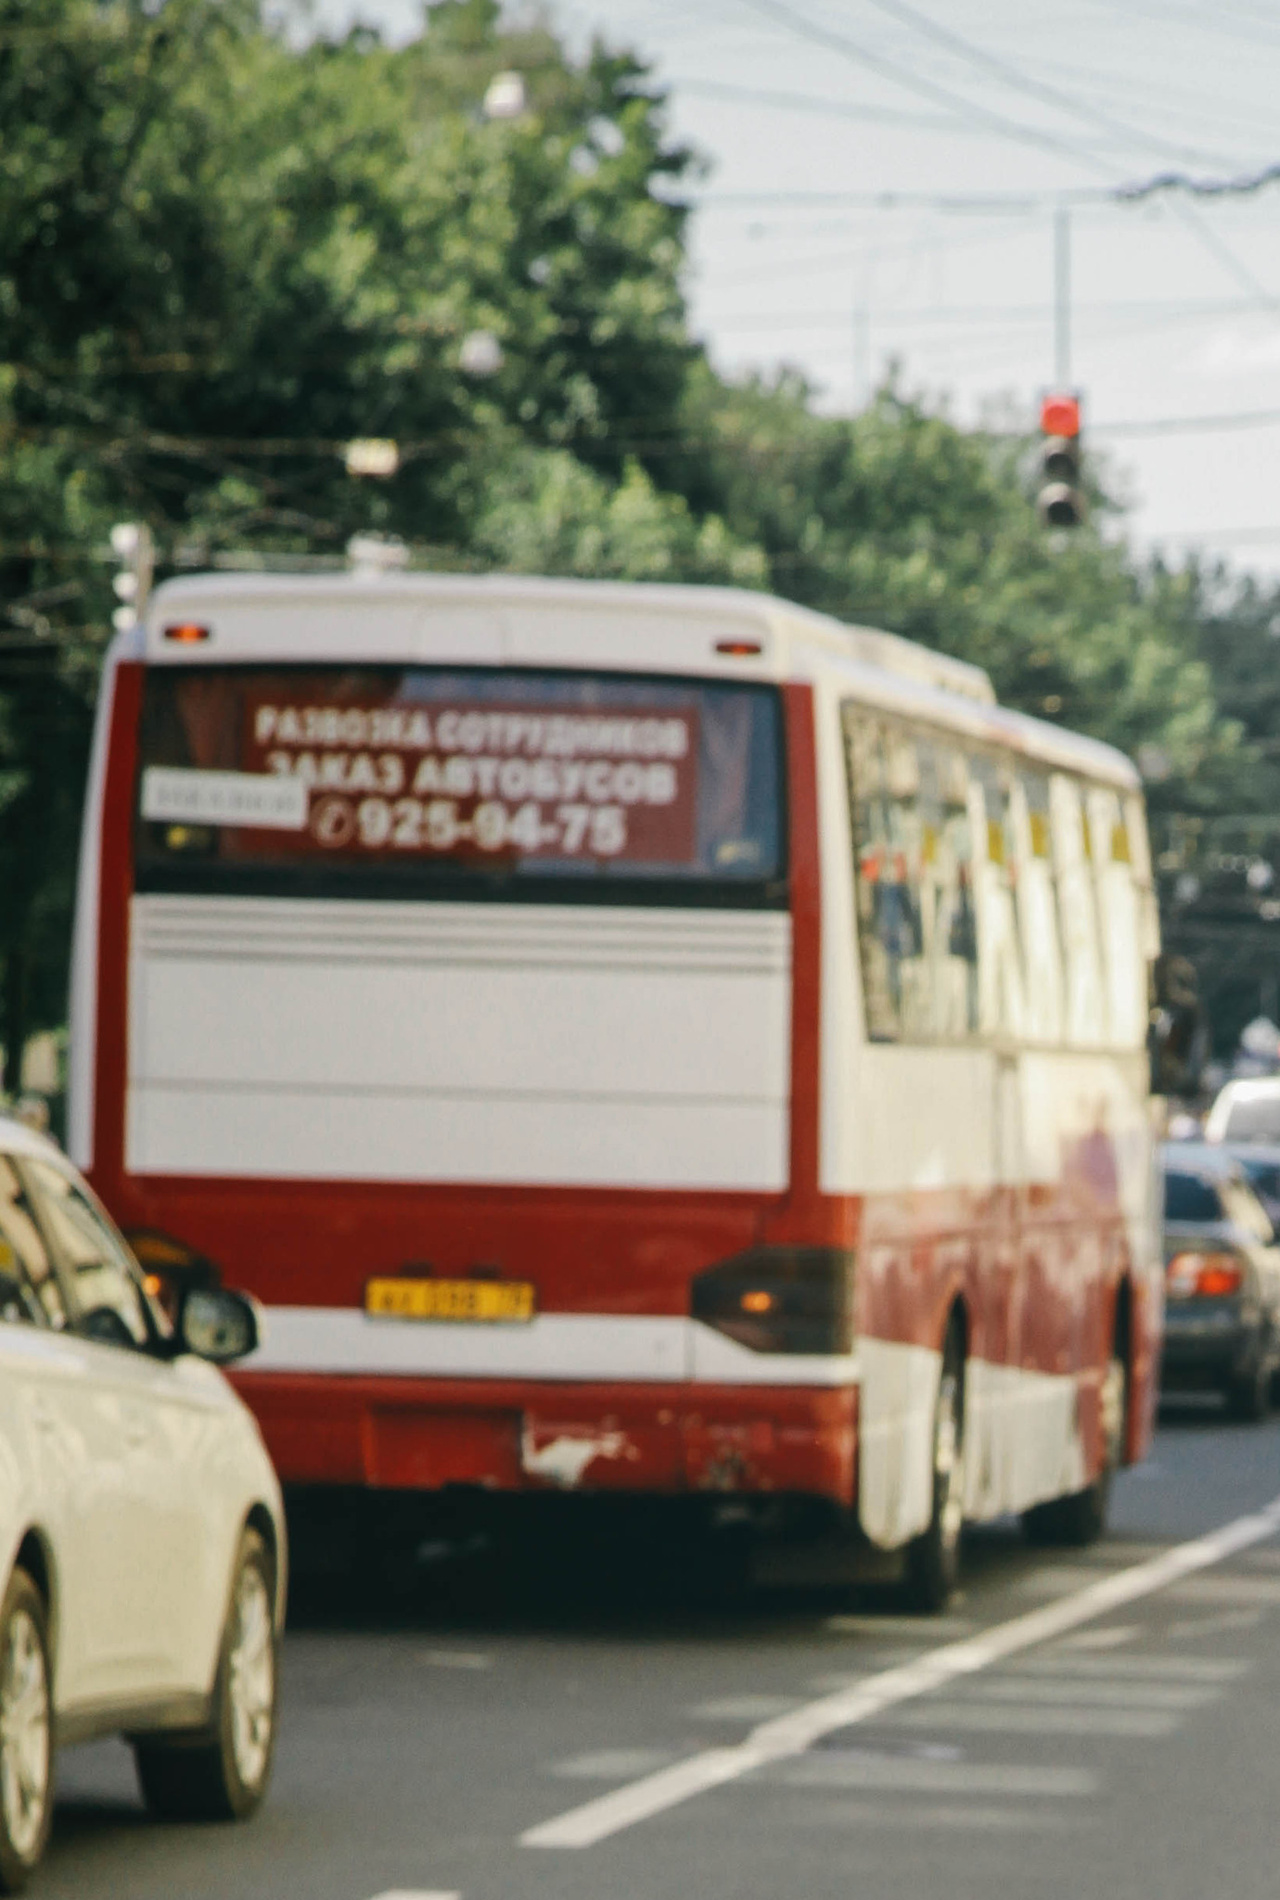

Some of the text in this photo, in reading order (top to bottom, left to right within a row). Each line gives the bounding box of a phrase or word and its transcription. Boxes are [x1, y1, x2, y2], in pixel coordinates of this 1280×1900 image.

[256, 706, 688, 758] РАЗВОЗКА СОТРУДНИКОВ
[413, 756, 676, 803] АВТОБУСОВ
